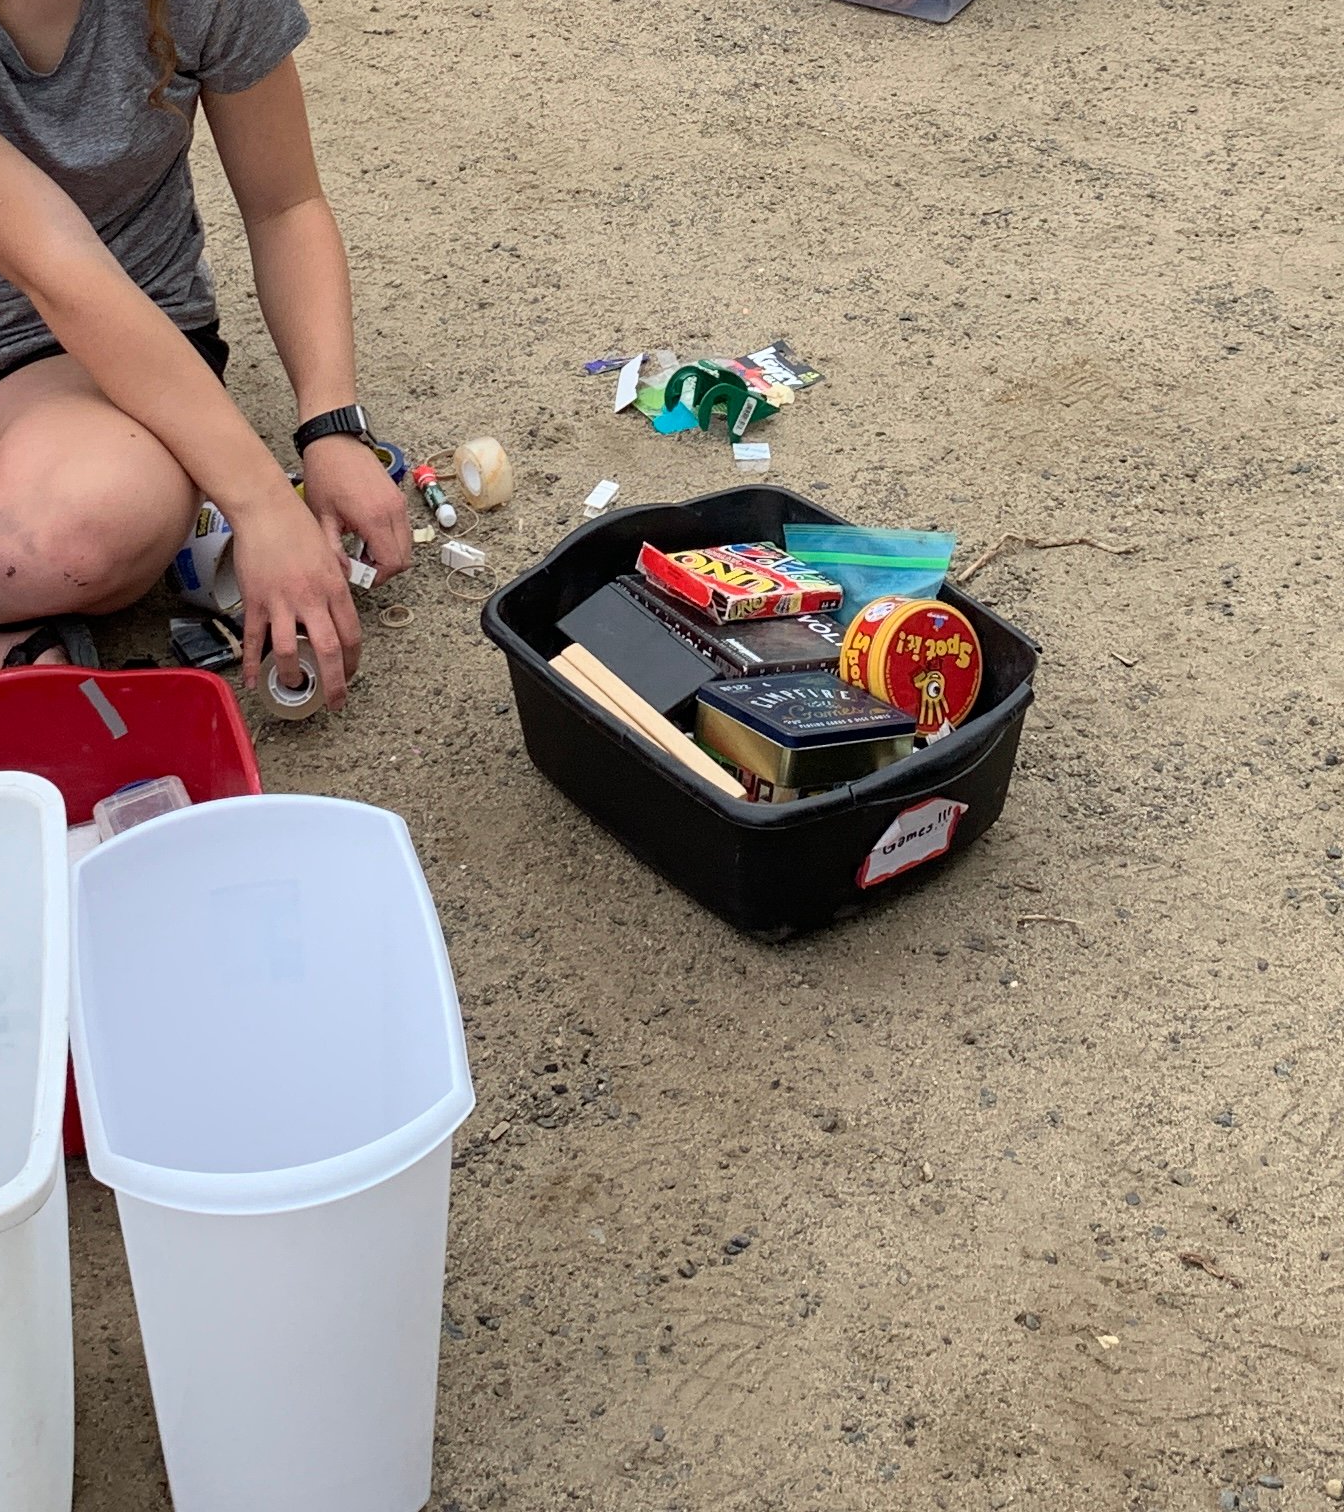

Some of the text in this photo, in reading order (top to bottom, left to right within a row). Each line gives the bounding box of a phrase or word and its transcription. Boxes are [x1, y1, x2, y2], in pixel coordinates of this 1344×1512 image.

[666, 549, 779, 594] UNO
[729, 595, 767, 619] UNO
[896, 631, 973, 669] Spot it!
[750, 687, 852, 709] CAMPFIRE
